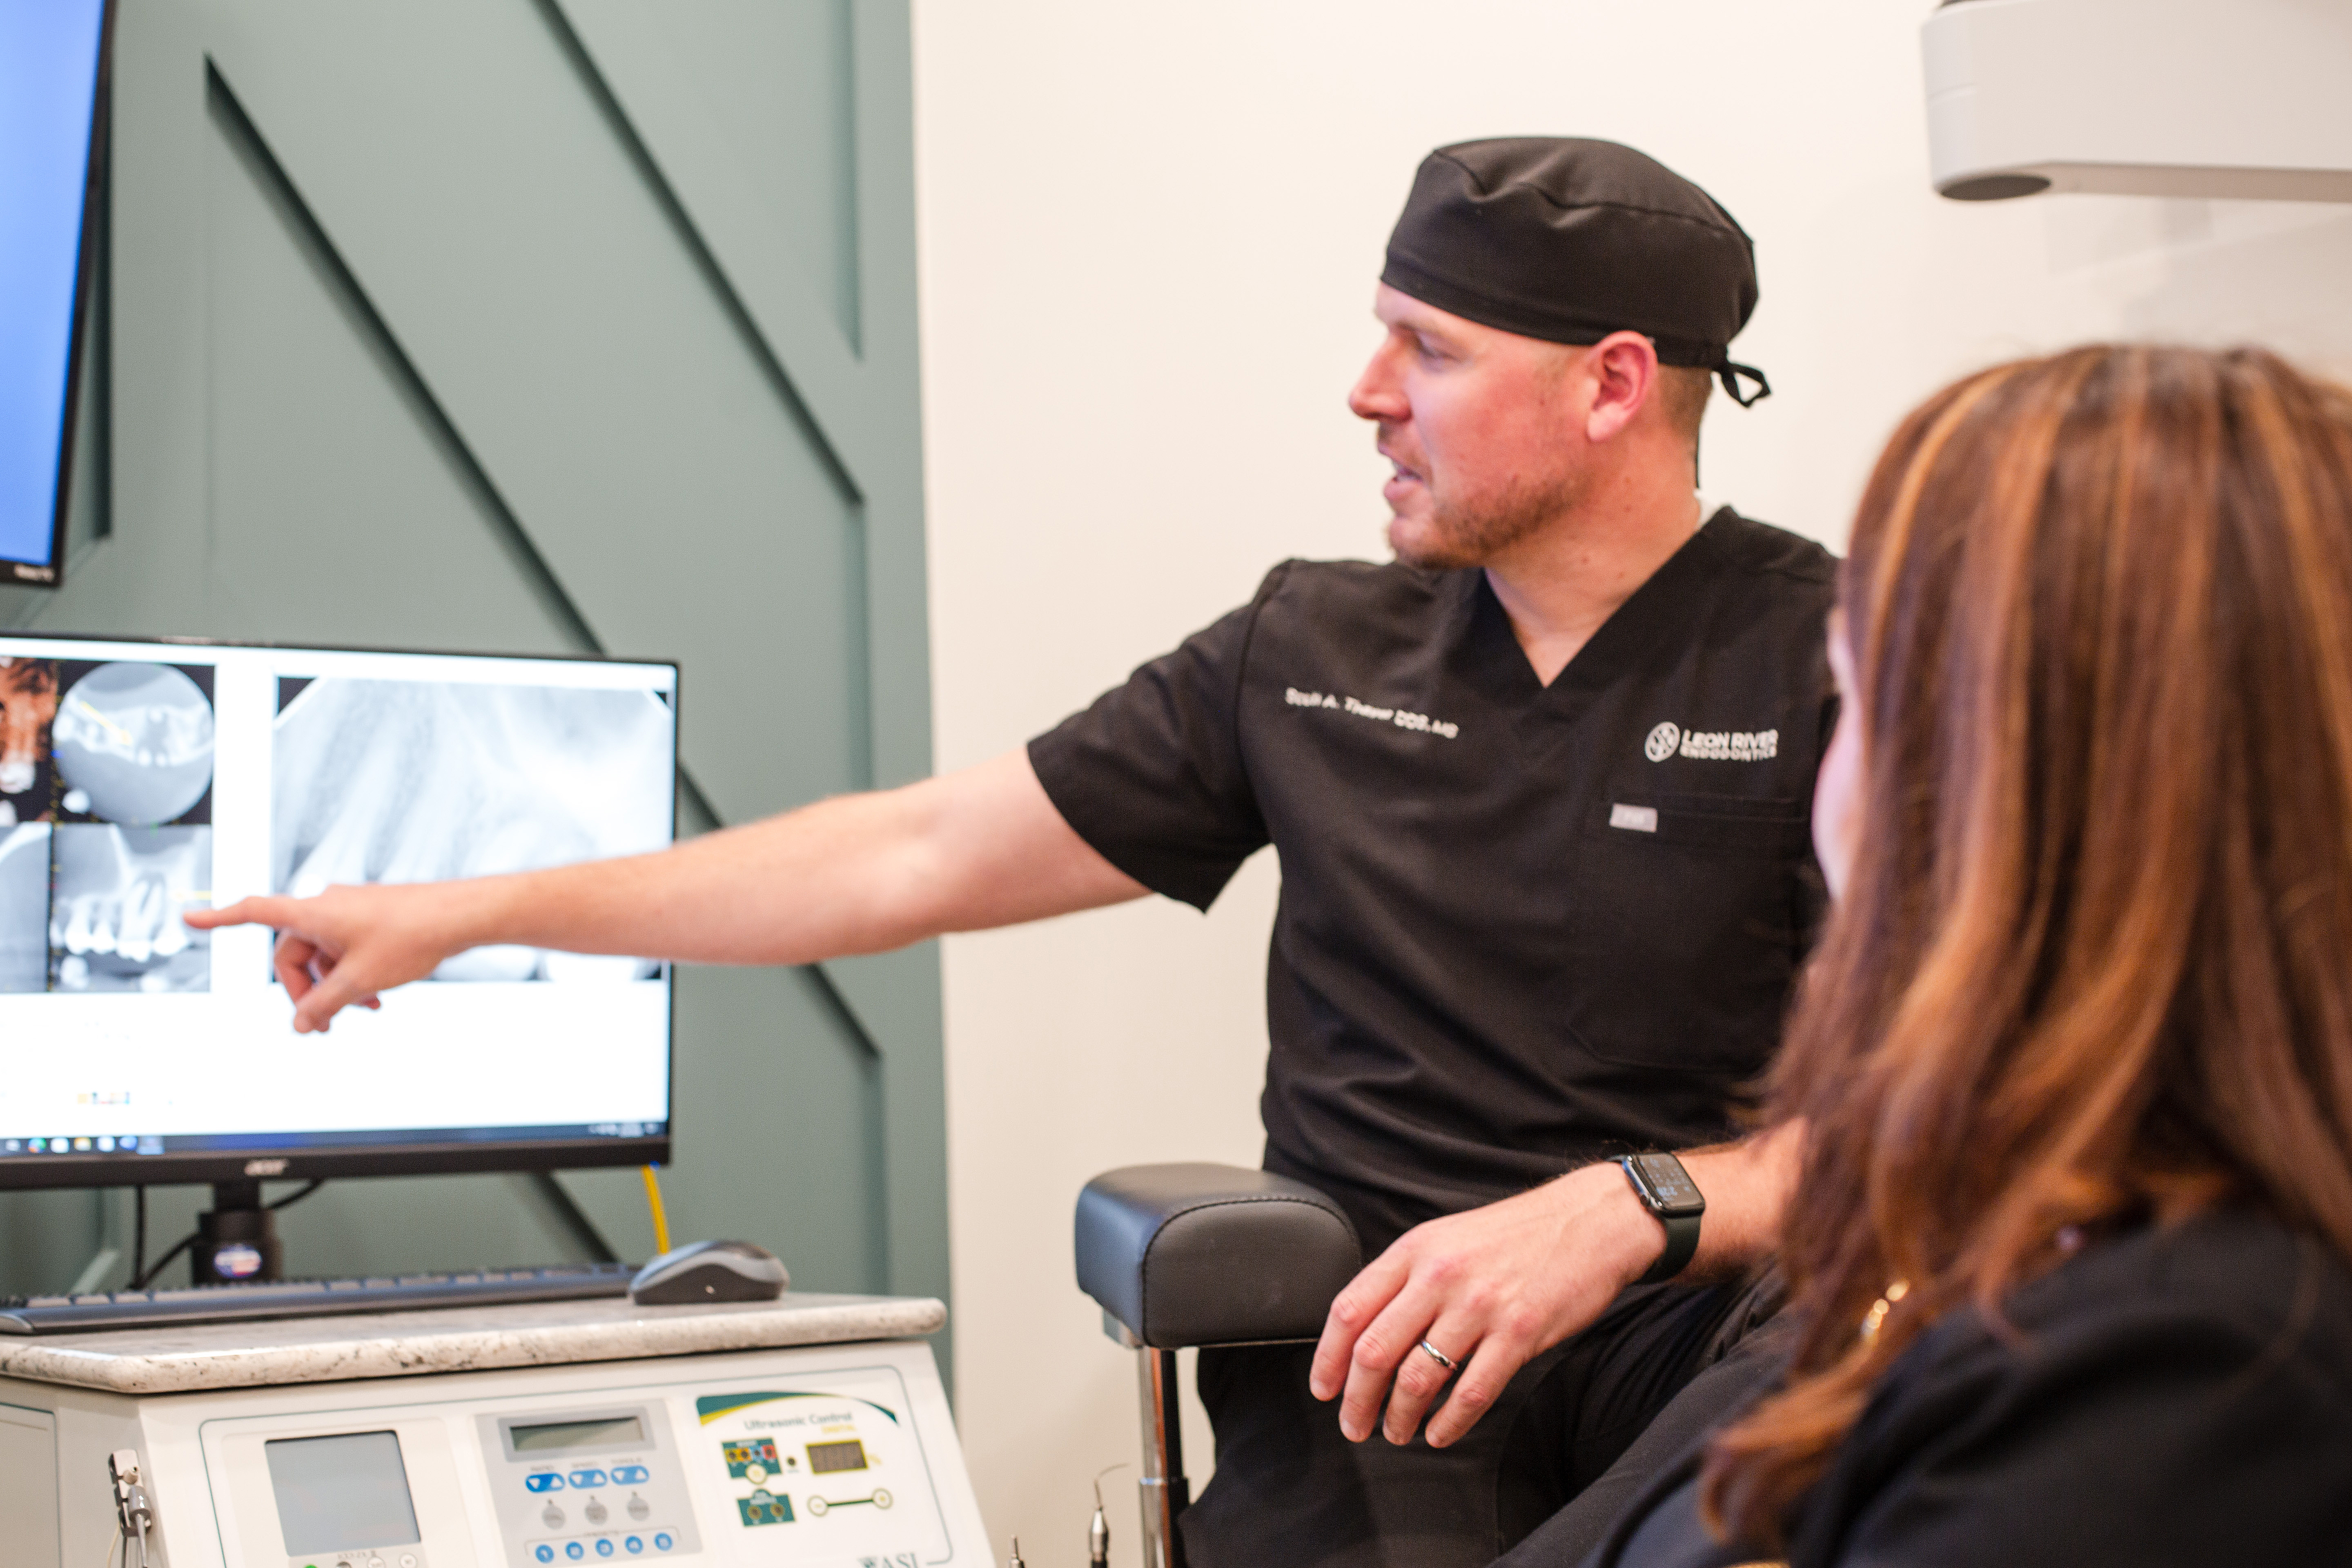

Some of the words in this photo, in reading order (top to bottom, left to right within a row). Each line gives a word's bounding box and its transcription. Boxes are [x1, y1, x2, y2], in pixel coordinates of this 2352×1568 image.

[1681, 729, 1730, 748] LEON
[744, 1417, 806, 1430] Ultrasonic
[808, 1411, 852, 1424] Control
